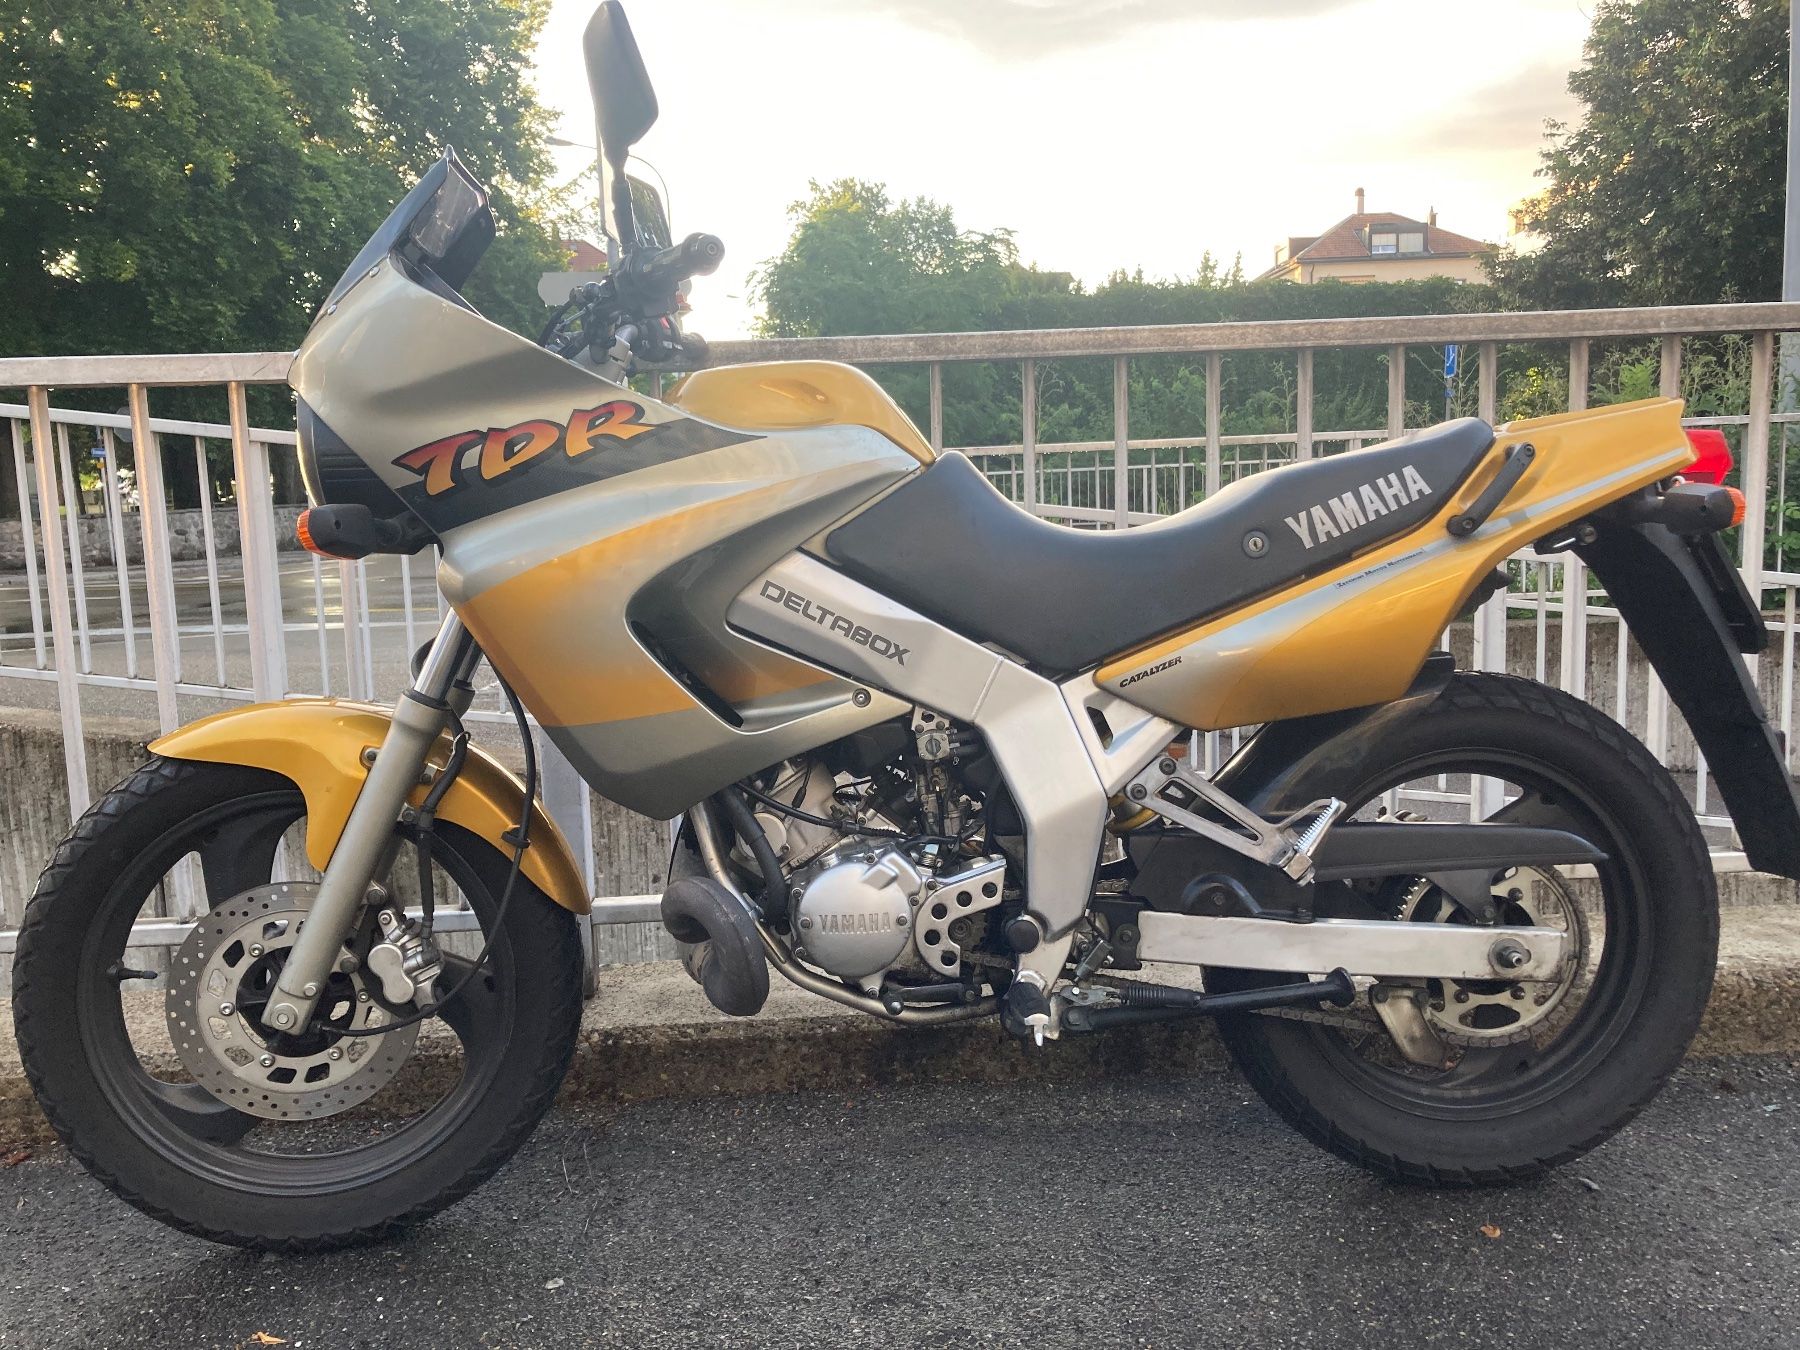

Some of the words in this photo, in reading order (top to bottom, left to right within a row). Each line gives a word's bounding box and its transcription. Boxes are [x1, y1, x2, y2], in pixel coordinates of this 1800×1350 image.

[391, 400, 658, 497] TDR
[1284, 465, 1432, 550] YAMAHA
[759, 580, 911, 666] DELTABOX
[1119, 655, 1182, 688] CATALYZER
[819, 912, 892, 934] YAMAHA
